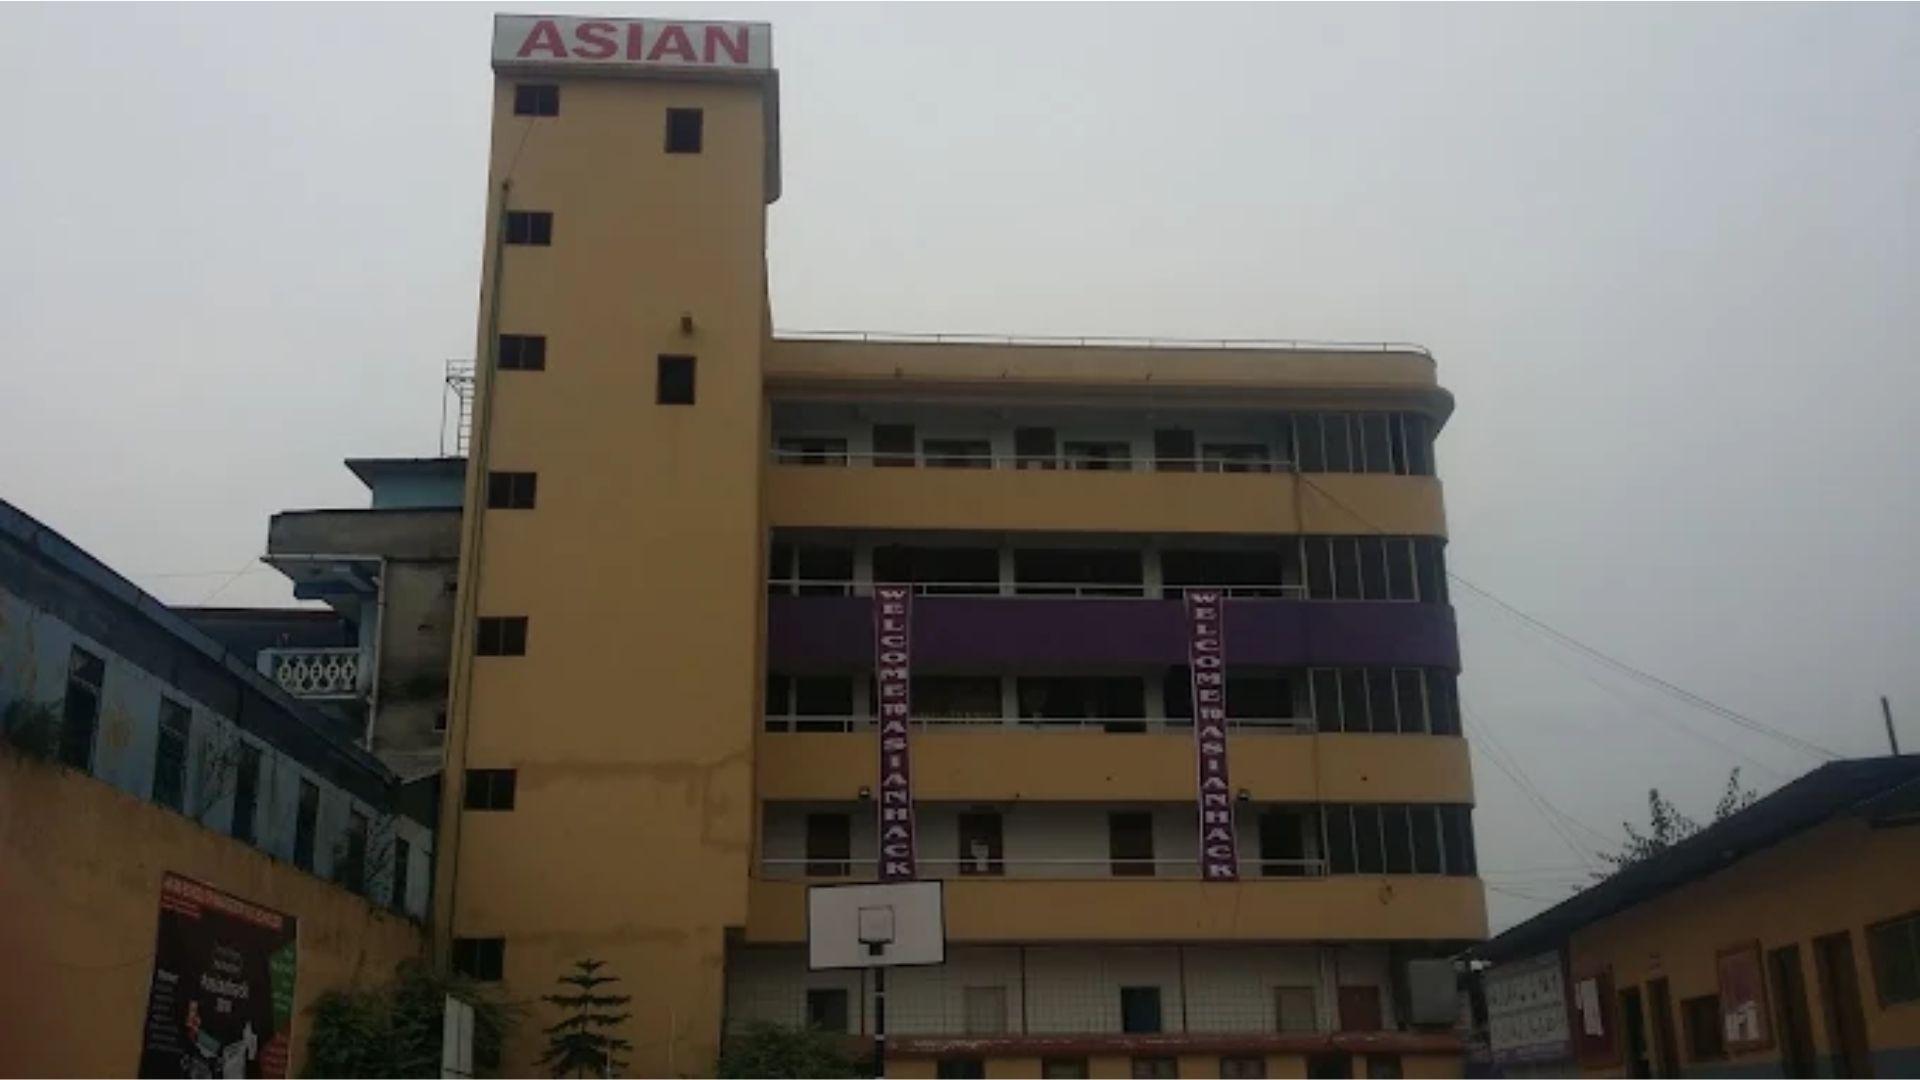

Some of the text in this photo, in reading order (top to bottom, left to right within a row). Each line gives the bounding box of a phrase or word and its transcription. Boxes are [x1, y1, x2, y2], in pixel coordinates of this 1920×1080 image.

[516, 20, 749, 63] ASIAN
[880, 590, 911, 875] WELCOME TO ASIANHACK
[1192, 593, 1234, 877] WELCOME TO ASIANHACK
